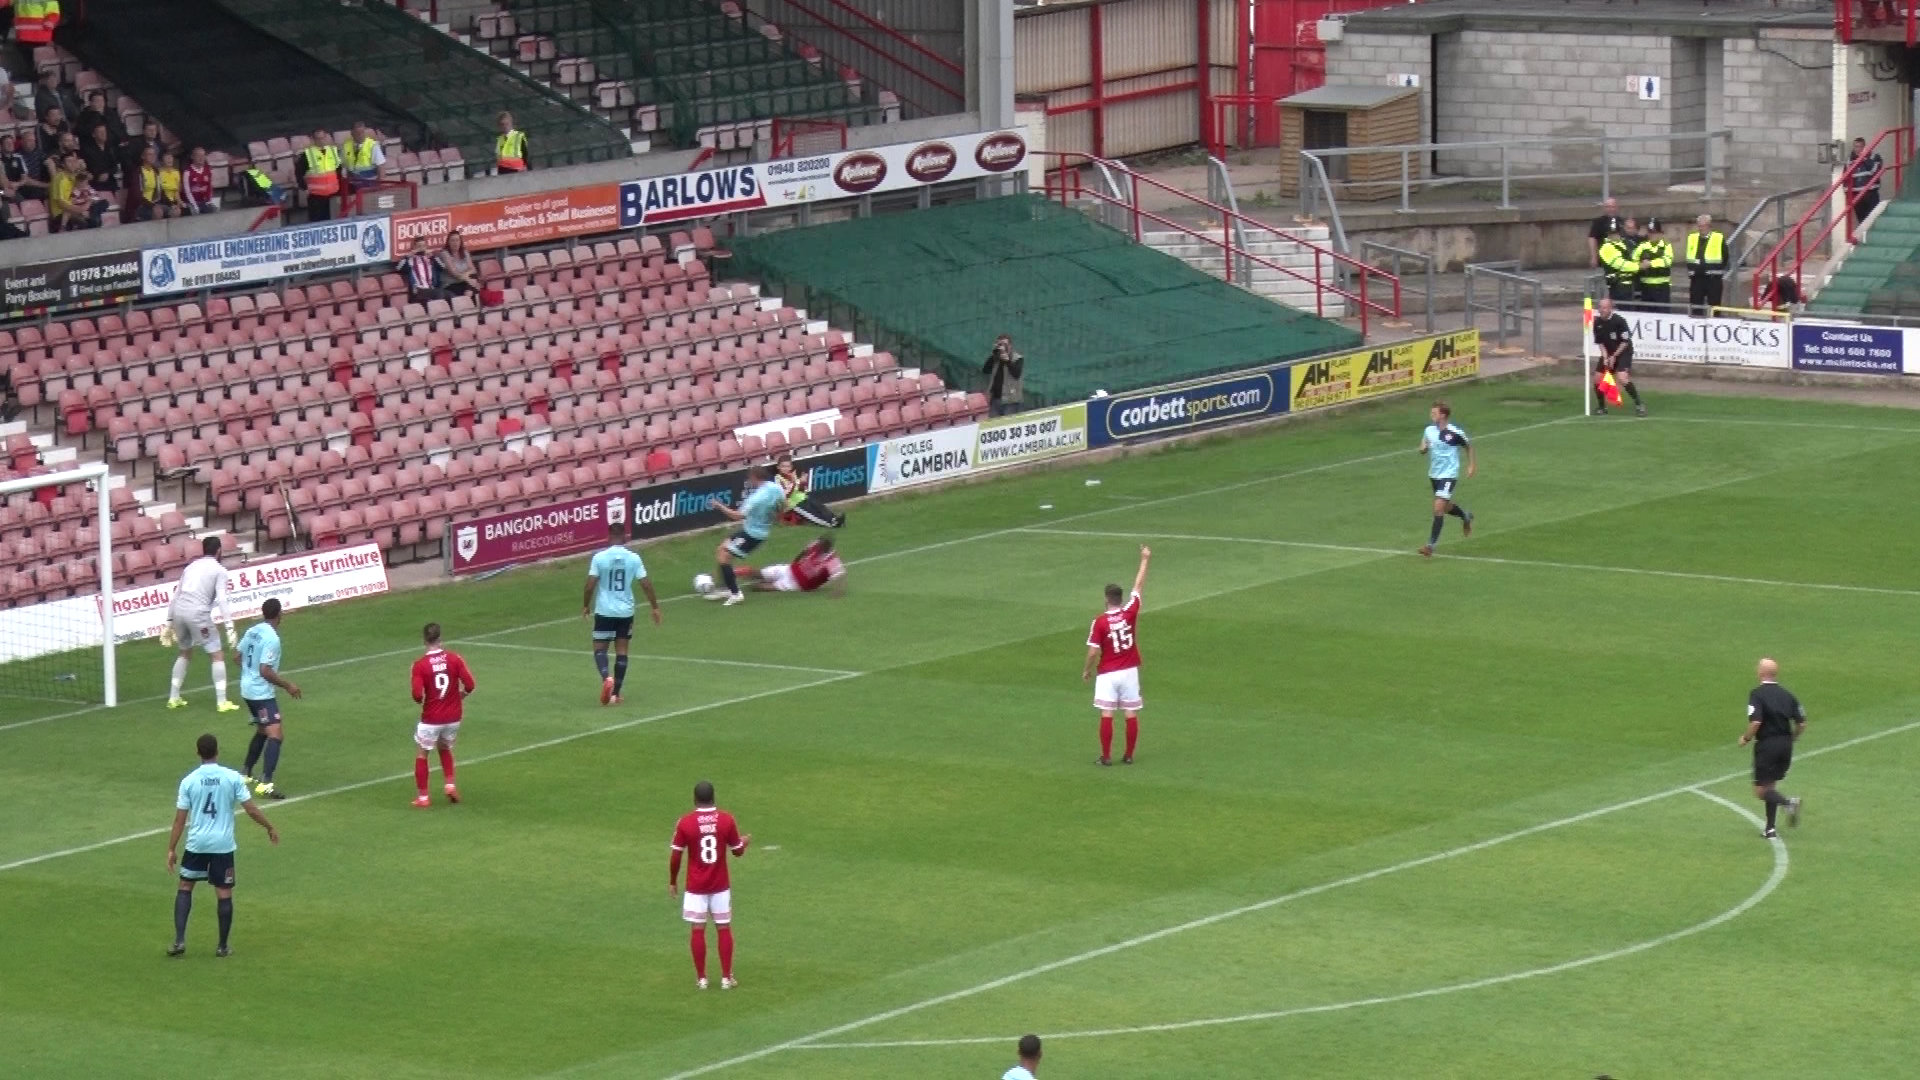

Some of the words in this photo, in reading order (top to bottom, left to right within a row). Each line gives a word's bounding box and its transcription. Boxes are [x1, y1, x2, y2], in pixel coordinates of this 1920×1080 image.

[620, 166, 756, 227] BARLOWS
[398, 219, 448, 240] BOOKER
[498, 215, 537, 231] Retailers
[539, 213, 547, 225] &
[548, 208, 571, 224] Small
[571, 205, 617, 220] Businesses
[224, 233, 290, 258] ENGINEERING
[291, 227, 339, 248] SERVICES
[340, 224, 357, 242] LTD
[5, 277, 28, 290] Event
[29, 273, 46, 286] and
[69, 266, 101, 283] 01978
[5, 292, 27, 306] Party
[27, 288, 61, 302] Booking
[1821, 331, 1858, 342] Contact
[1859, 333, 1873, 343] Us
[1359, 349, 1393, 386] AH
[1420, 336, 1455, 374] AH
[1294, 362, 1330, 399] AH
[1120, 389, 1261, 428] corbettsports.com
[980, 429, 1007, 445] 0300
[1009, 426, 1022, 440] 30
[1023, 424, 1037, 437] 30
[1039, 419, 1057, 434] 007
[980, 431, 1082, 462] WWW.CAMBRIA.AC.UK
[900, 438, 933, 456] COLEG
[900, 449, 969, 479] CAMBRIA
[485, 503, 600, 541] BANGOR-ON-DEE
[511, 531, 574, 552] RACECOURSE
[239, 572, 251, 588] &
[256, 564, 308, 586] Astons
[310, 550, 380, 574] Furniture
[609, 568, 626, 592] 19
[112, 589, 169, 614] hosddu
[1107, 624, 1133, 654] 15
[435, 673, 449, 700] 9
[202, 791, 217, 820] 4
[700, 835, 718, 864] 8
